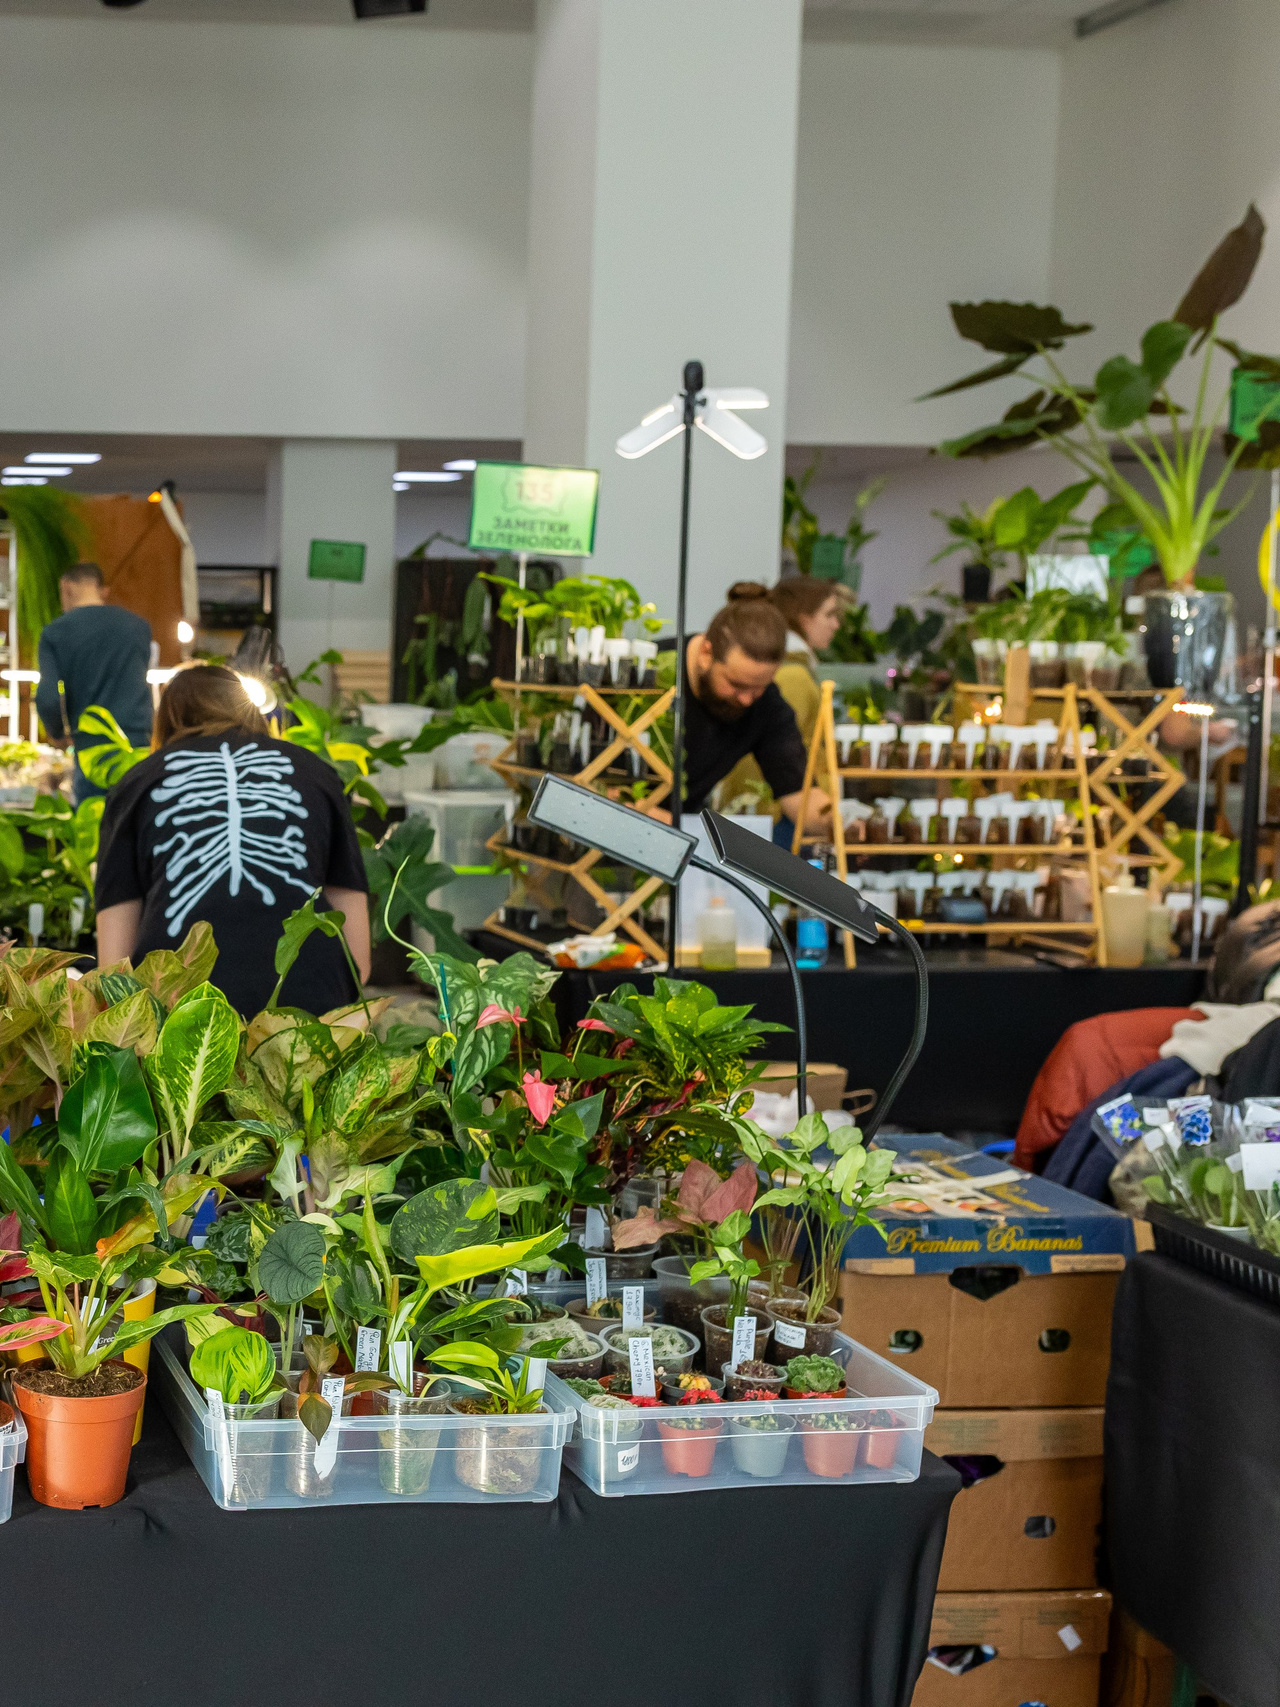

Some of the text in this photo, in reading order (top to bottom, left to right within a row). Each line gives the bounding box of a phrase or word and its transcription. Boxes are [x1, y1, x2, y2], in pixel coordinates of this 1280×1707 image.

[493, 515, 569, 534] ЗАМЕТКИ
[886, 1225, 1083, 1254] Premium Bananas
